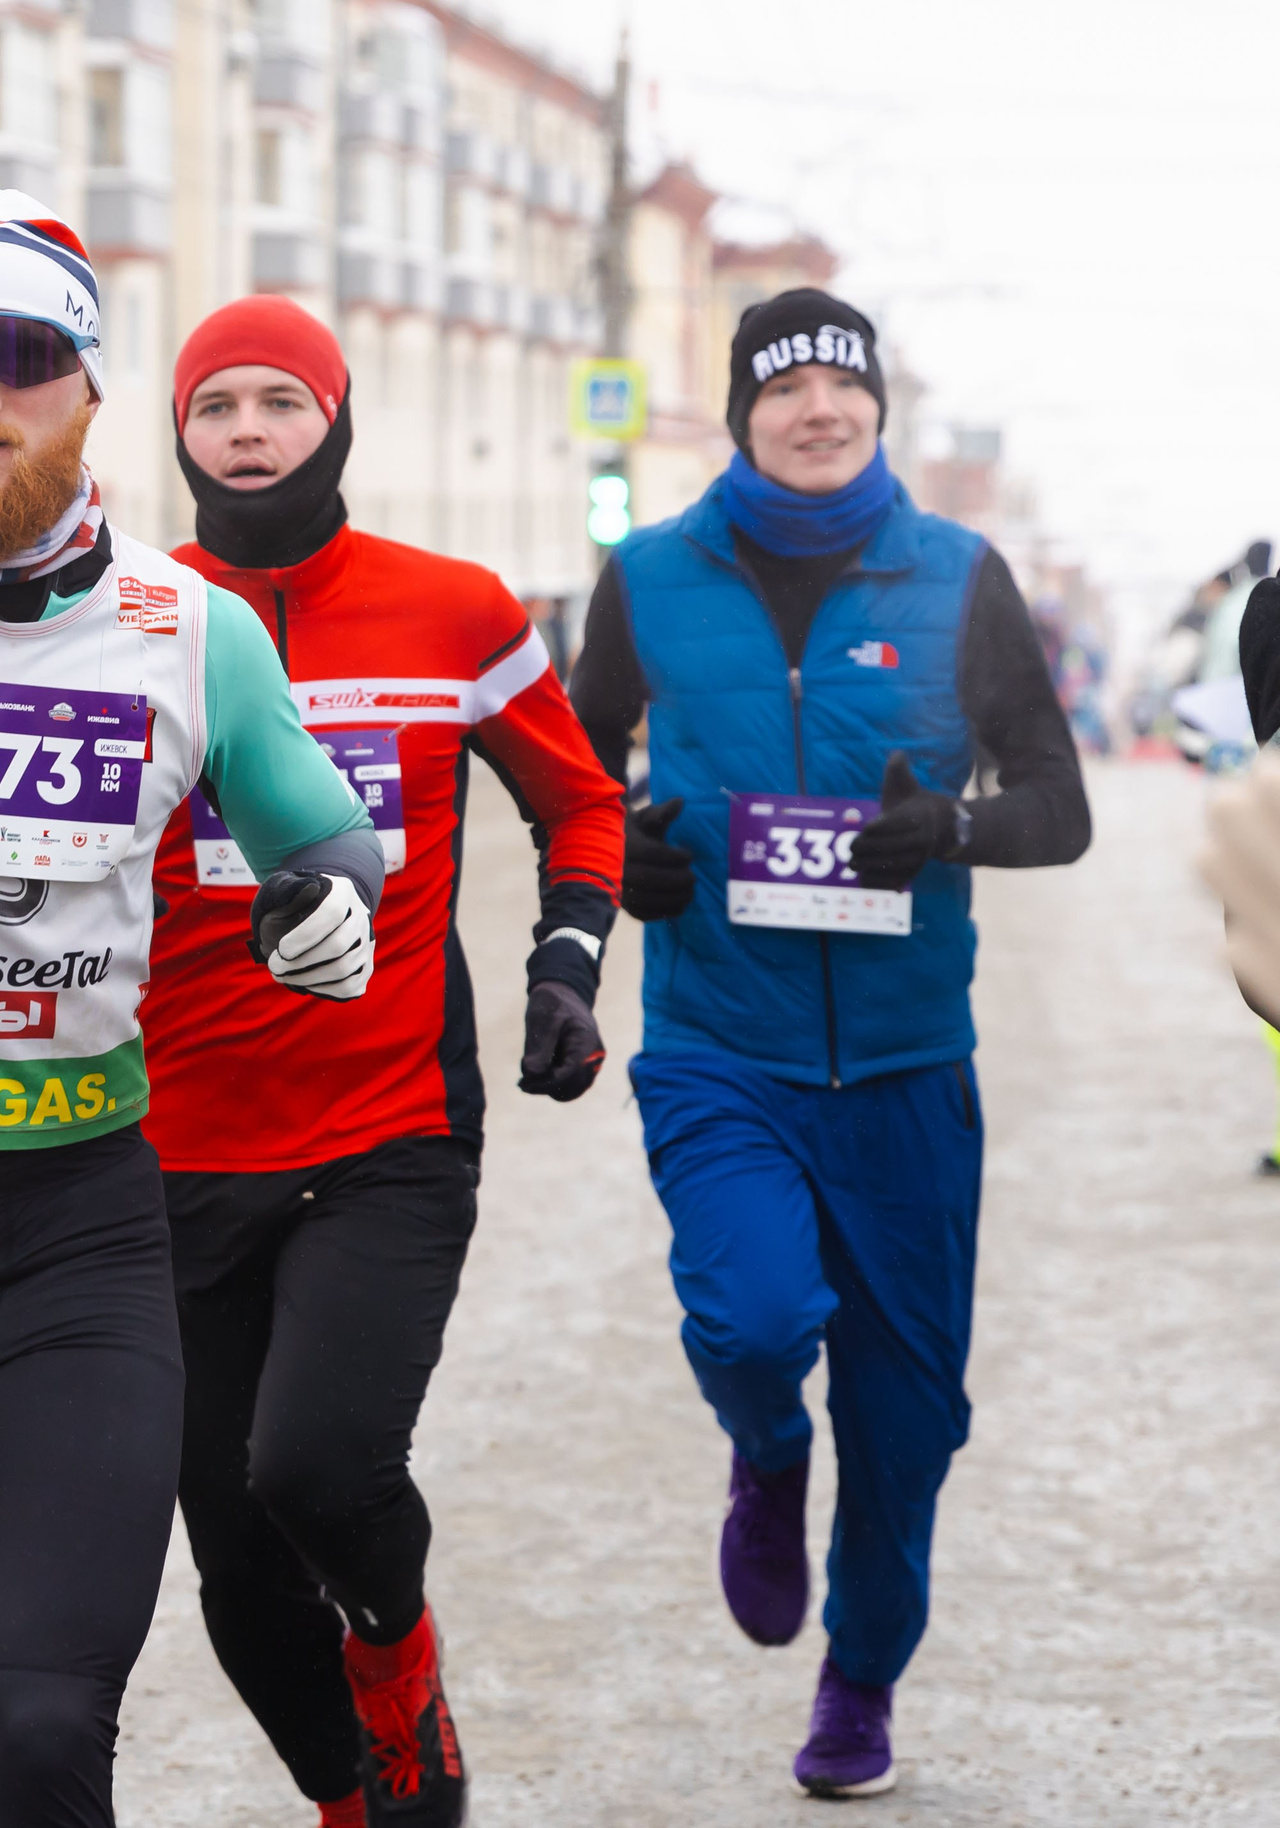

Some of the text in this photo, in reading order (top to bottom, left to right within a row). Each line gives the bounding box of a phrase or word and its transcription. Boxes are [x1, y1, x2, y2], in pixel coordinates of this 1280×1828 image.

[752, 332, 868, 382] RUSSIA
[100, 743, 128, 754] ИЖЕВСК
[101, 763, 121, 779] 10
[100, 779, 120, 792] КМ
[364, 783, 383, 797] 10
